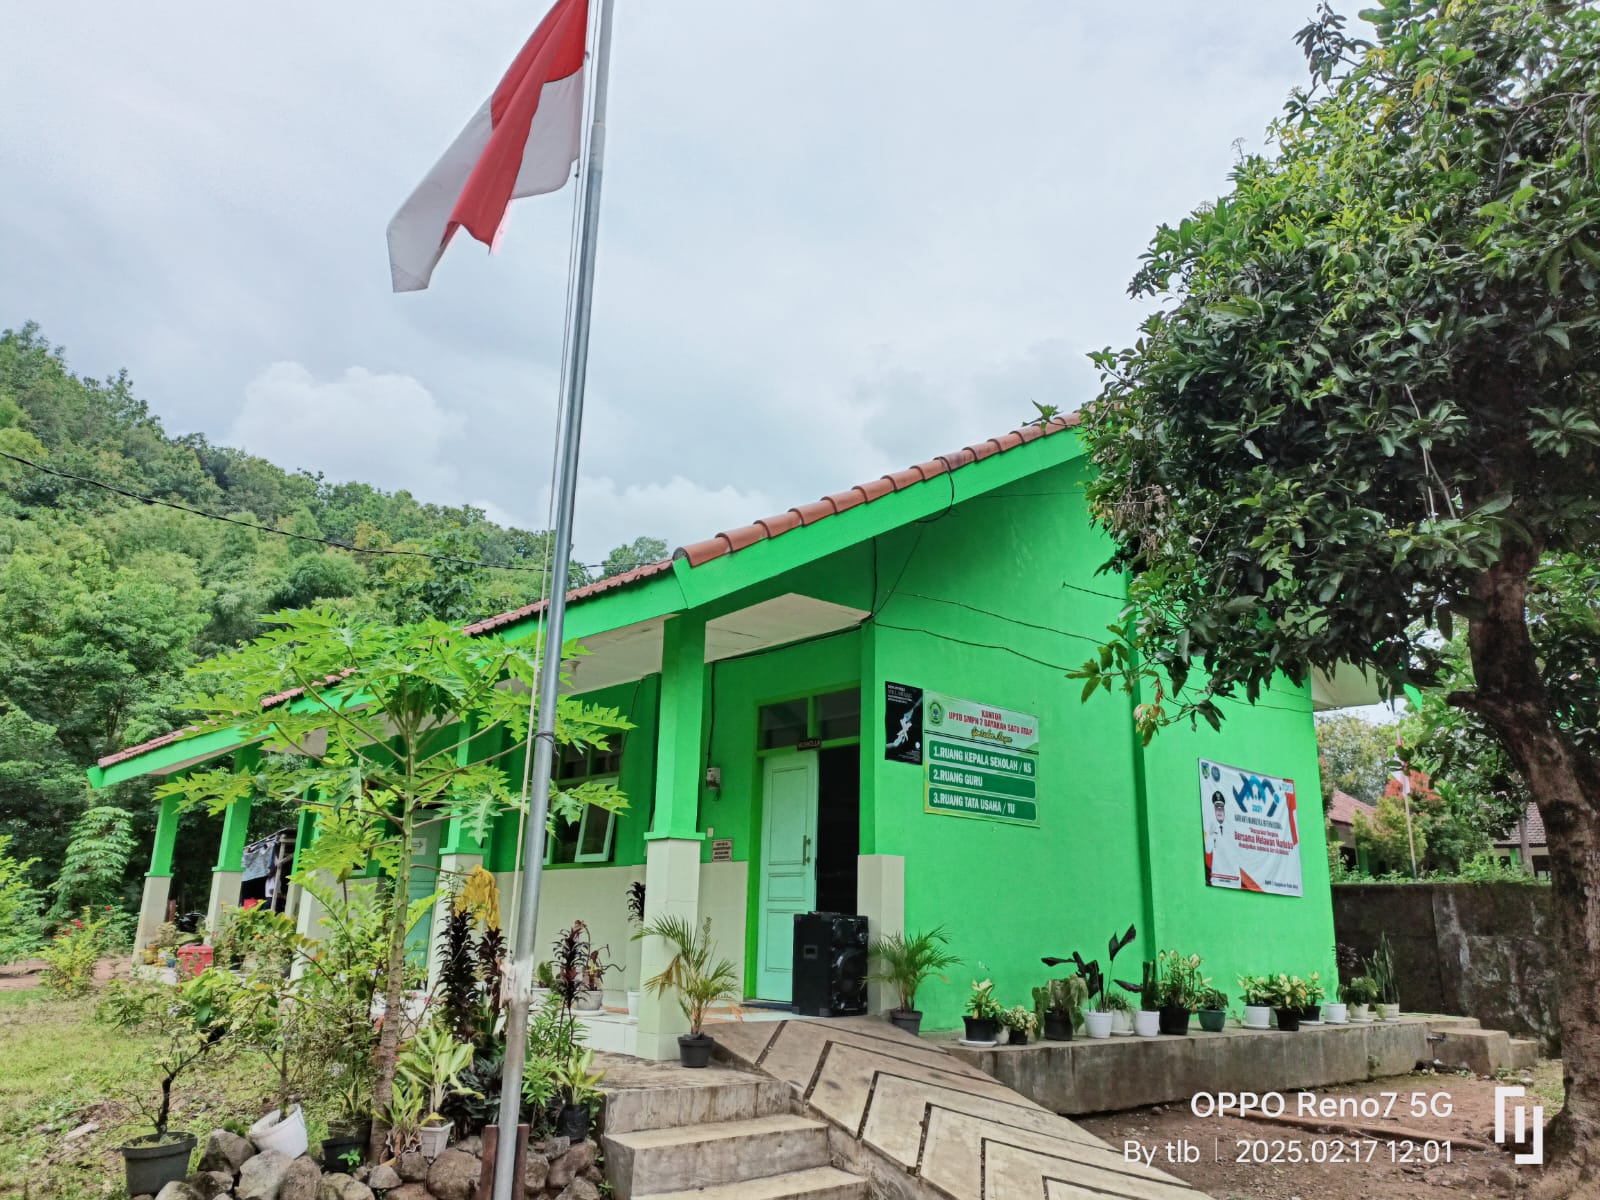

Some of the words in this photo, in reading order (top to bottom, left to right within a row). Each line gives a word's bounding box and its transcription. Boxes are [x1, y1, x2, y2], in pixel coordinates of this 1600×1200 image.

[964, 751, 989, 766] KEPALA
[990, 757, 1018, 771] SEKOLAH
[1023, 762, 1032, 774] KS
[964, 775, 983, 787] GURU
[964, 796, 979, 809] TATA
[980, 799, 1002, 813] USAHA
[1007, 802, 1015, 815] TU
[1234, 831, 1255, 844] Bersama
[1255, 835, 1276, 847] Melawan
